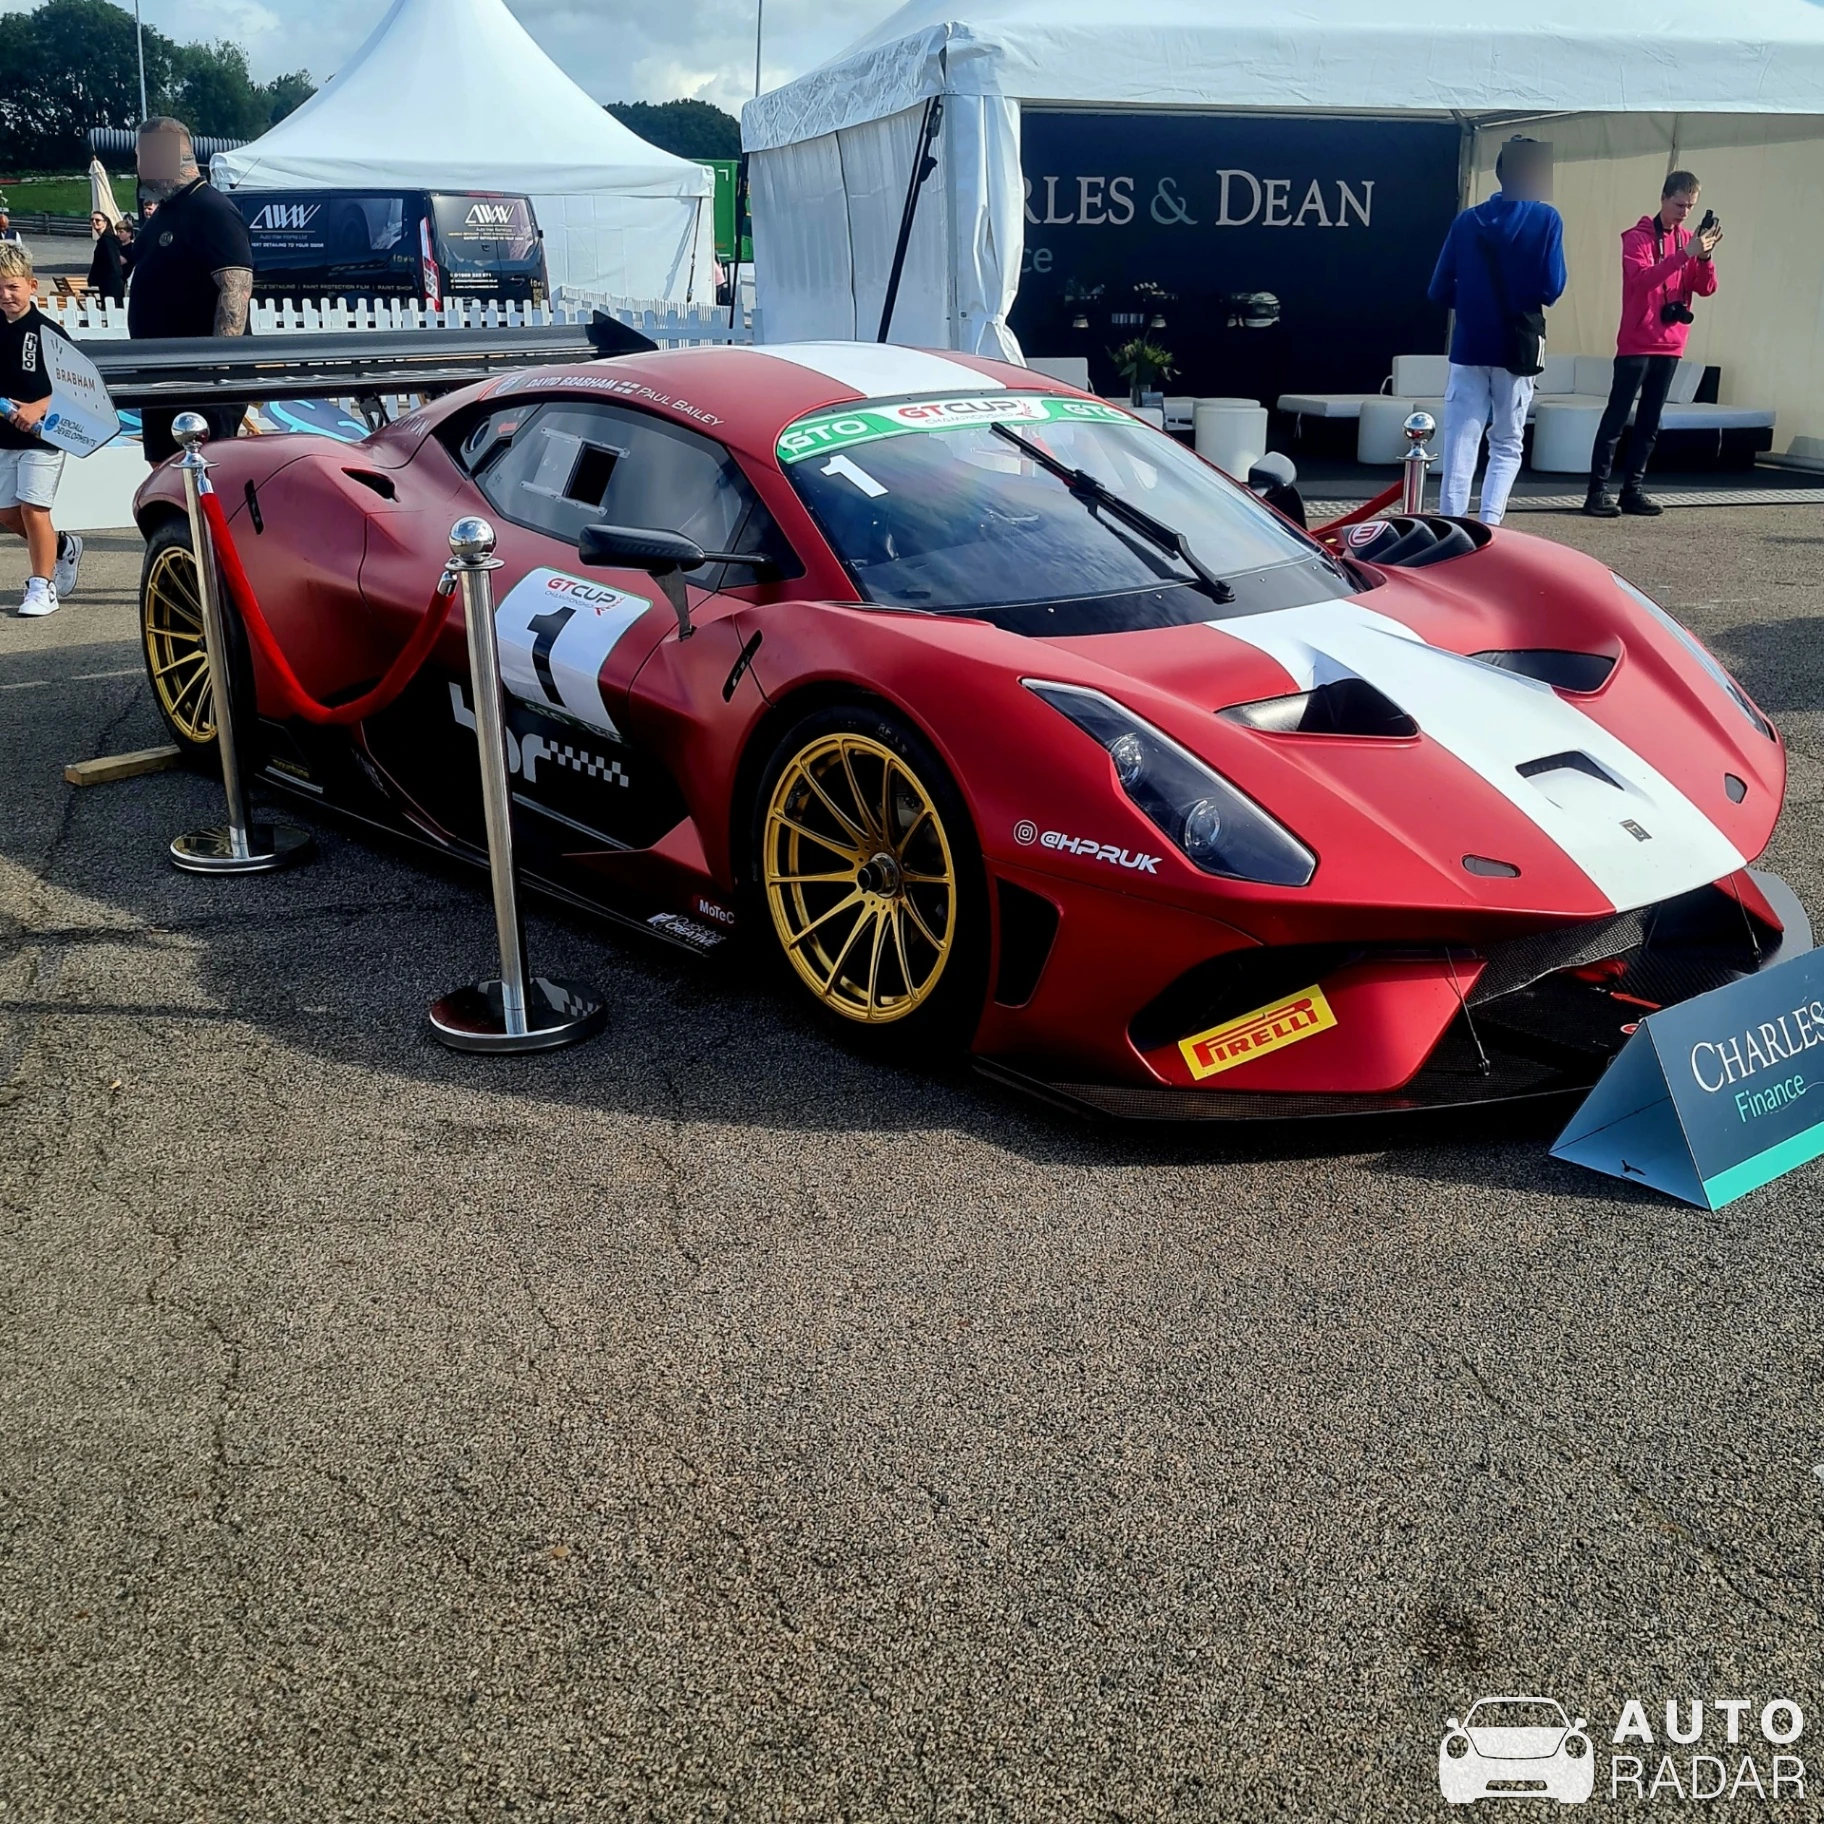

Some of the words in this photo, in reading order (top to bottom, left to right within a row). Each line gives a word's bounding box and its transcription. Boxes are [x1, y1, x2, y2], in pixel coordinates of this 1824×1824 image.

[1150, 176, 1199, 225] &
[1215, 169, 1375, 227] DEAN
[24, 333, 37, 369] HUGO
[56, 368, 96, 392] BRABHAM
[526, 375, 559, 389] DAVID
[561, 375, 618, 390] BRABHAM
[636, 386, 670, 406] PAUL
[671, 399, 725, 428] BAILEY
[780, 420, 868, 454] GTO
[820, 454, 889, 498] 1
[526, 606, 577, 708] 1
[1040, 831, 1163, 874] @HPRUK
[700, 899, 735, 924] MoTeC
[1192, 998, 1319, 1068] PIRELLI
[1691, 1001, 1824, 1092] CHARLES
[1735, 1074, 1807, 1123] Finance
